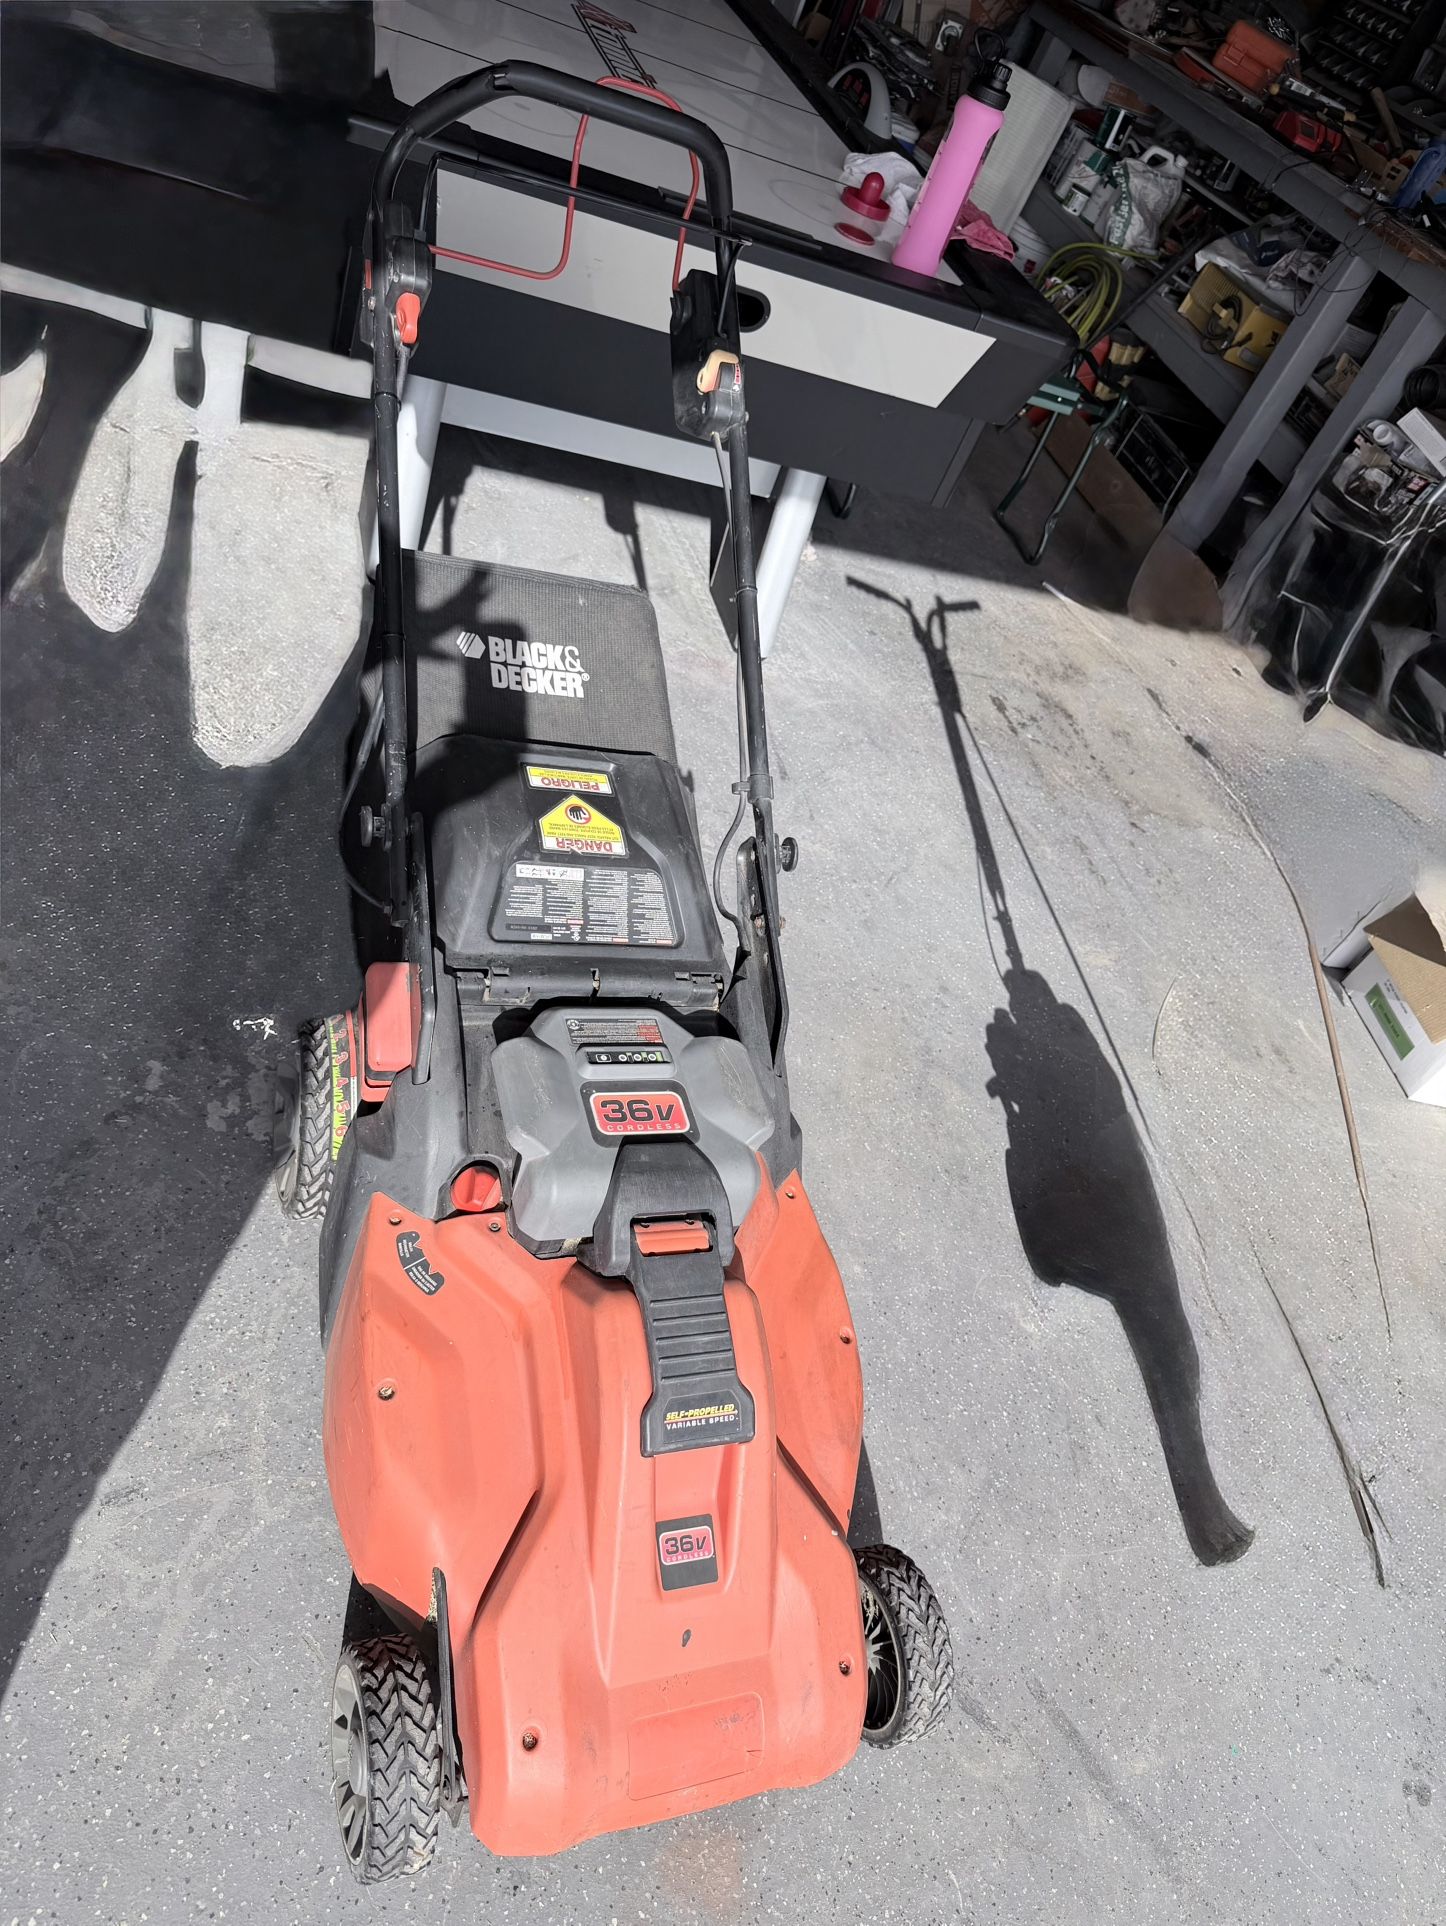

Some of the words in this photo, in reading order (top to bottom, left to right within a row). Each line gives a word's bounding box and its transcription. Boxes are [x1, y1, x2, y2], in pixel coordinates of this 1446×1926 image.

[488, 635, 585, 673] BLACK&
[541, 776, 600, 791] PELIGRO
[555, 837, 613, 853] DANGER
[606, 1123, 681, 1132] CORDLESS
[666, 1420, 706, 1430] VARIABLE
[709, 1415, 734, 1425] SPEED
